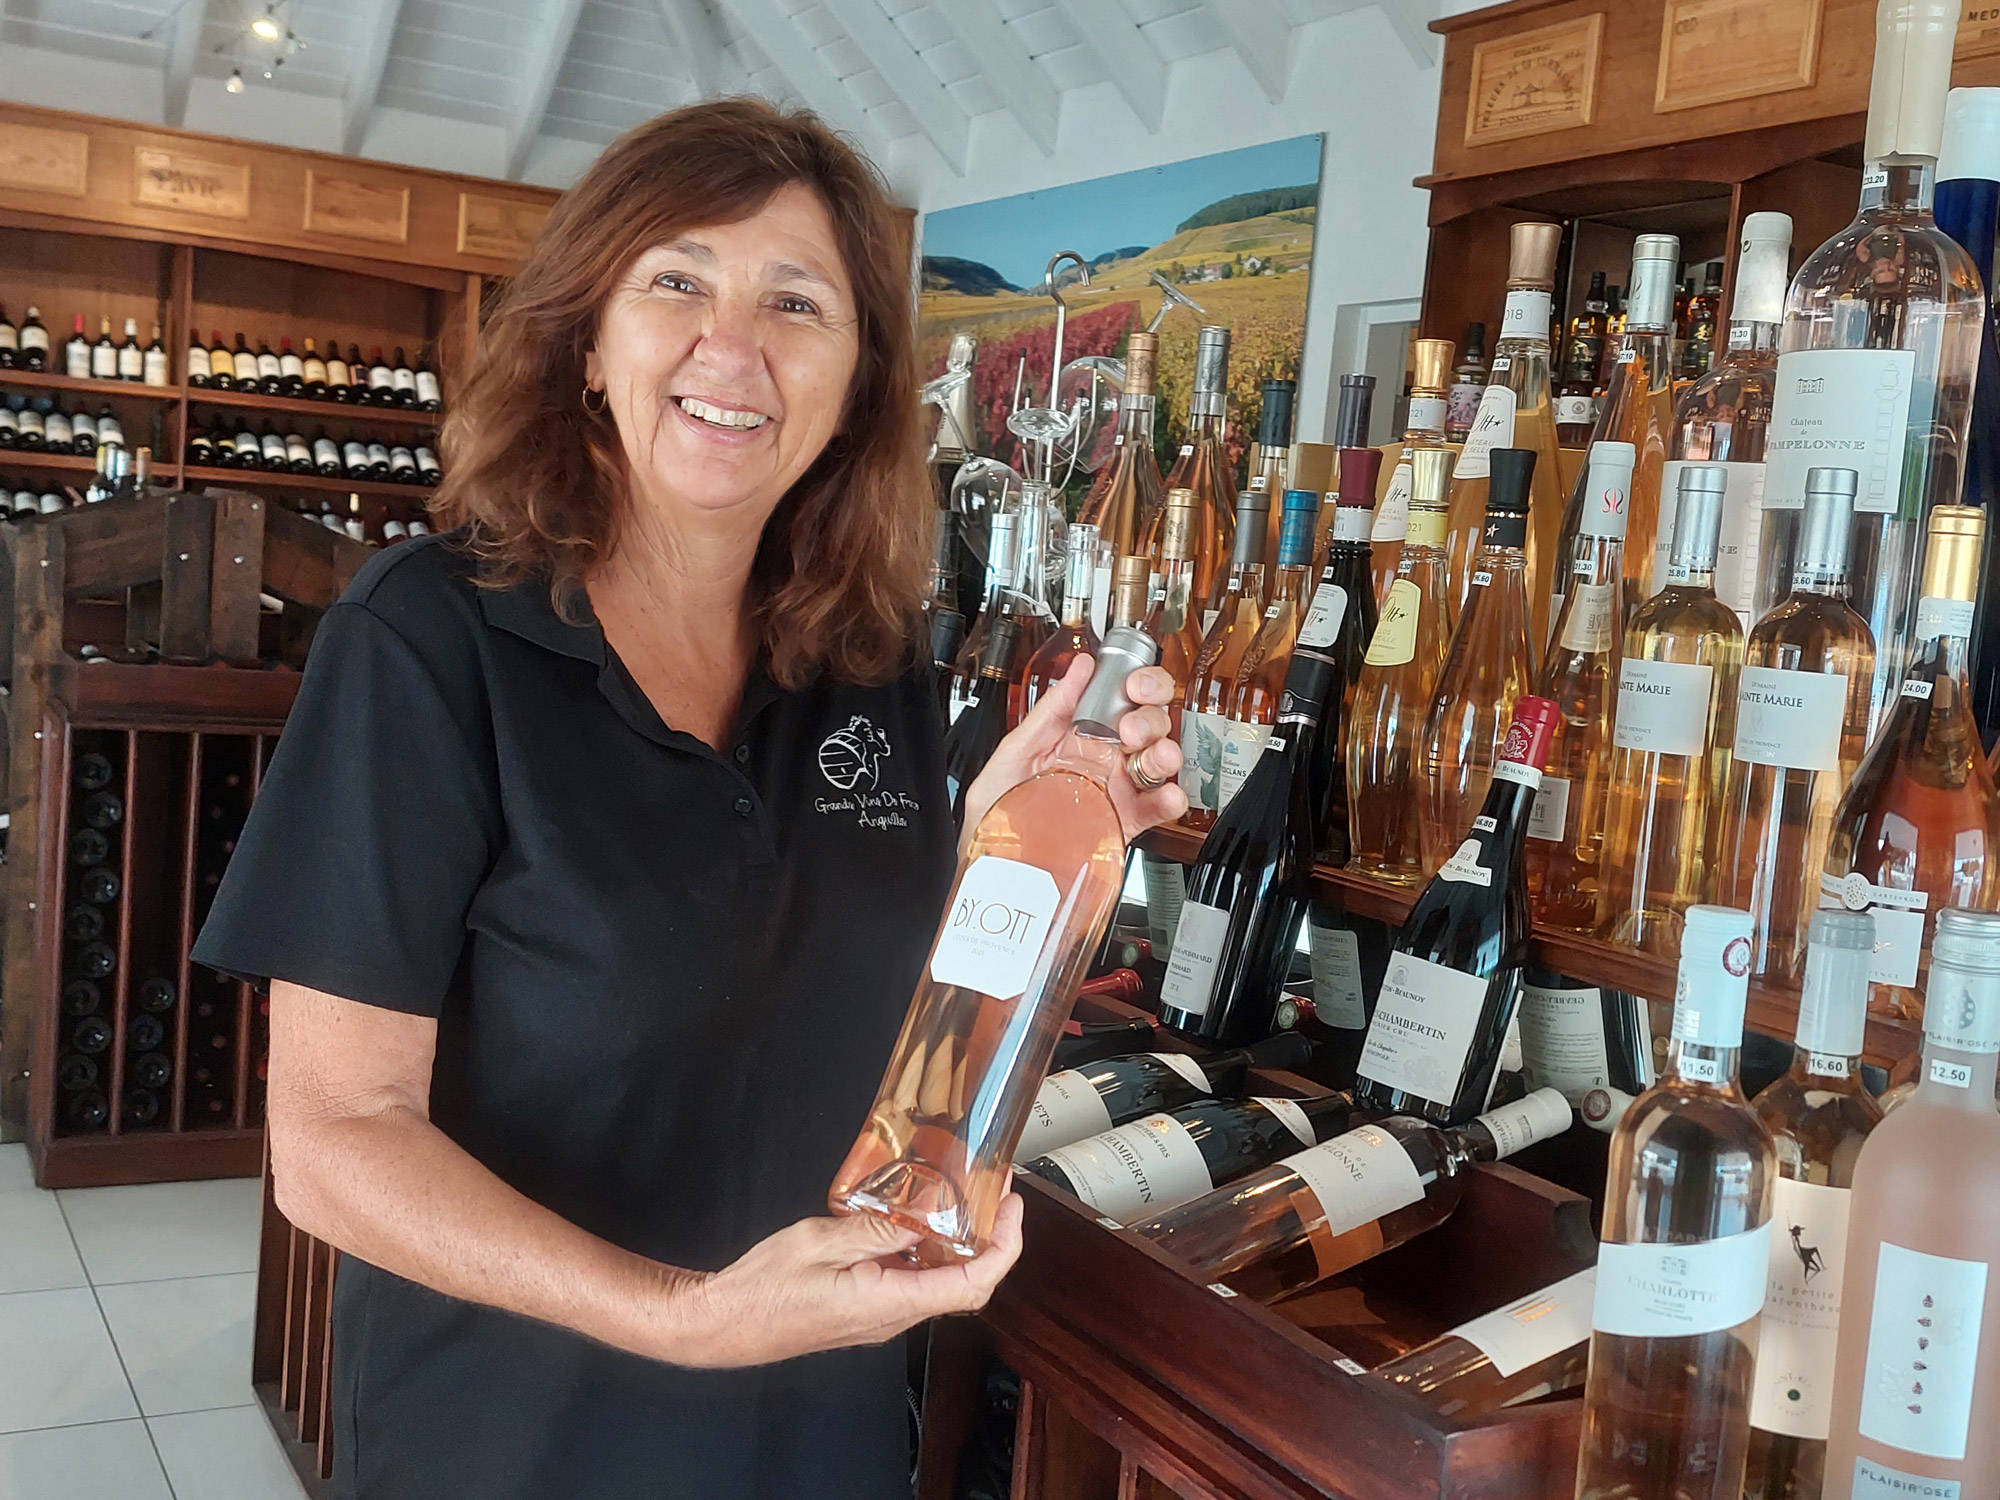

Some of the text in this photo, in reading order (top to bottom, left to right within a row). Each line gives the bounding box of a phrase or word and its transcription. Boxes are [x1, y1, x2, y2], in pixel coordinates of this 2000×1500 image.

[1636, 682, 1671, 695] MARIE
[1903, 684, 1928, 694] 24.00
[1764, 693, 1803, 708] MARIE
[1682, 1062, 1714, 1076] 11.50
[1811, 1057, 1843, 1071] 16.60
[1931, 1064, 1966, 1081] 12.50
[1158, 1143, 1171, 1159] FILS
[1100, 1132, 1153, 1204] CHAMBERTIN
[1772, 1281, 1835, 1300] la petite
